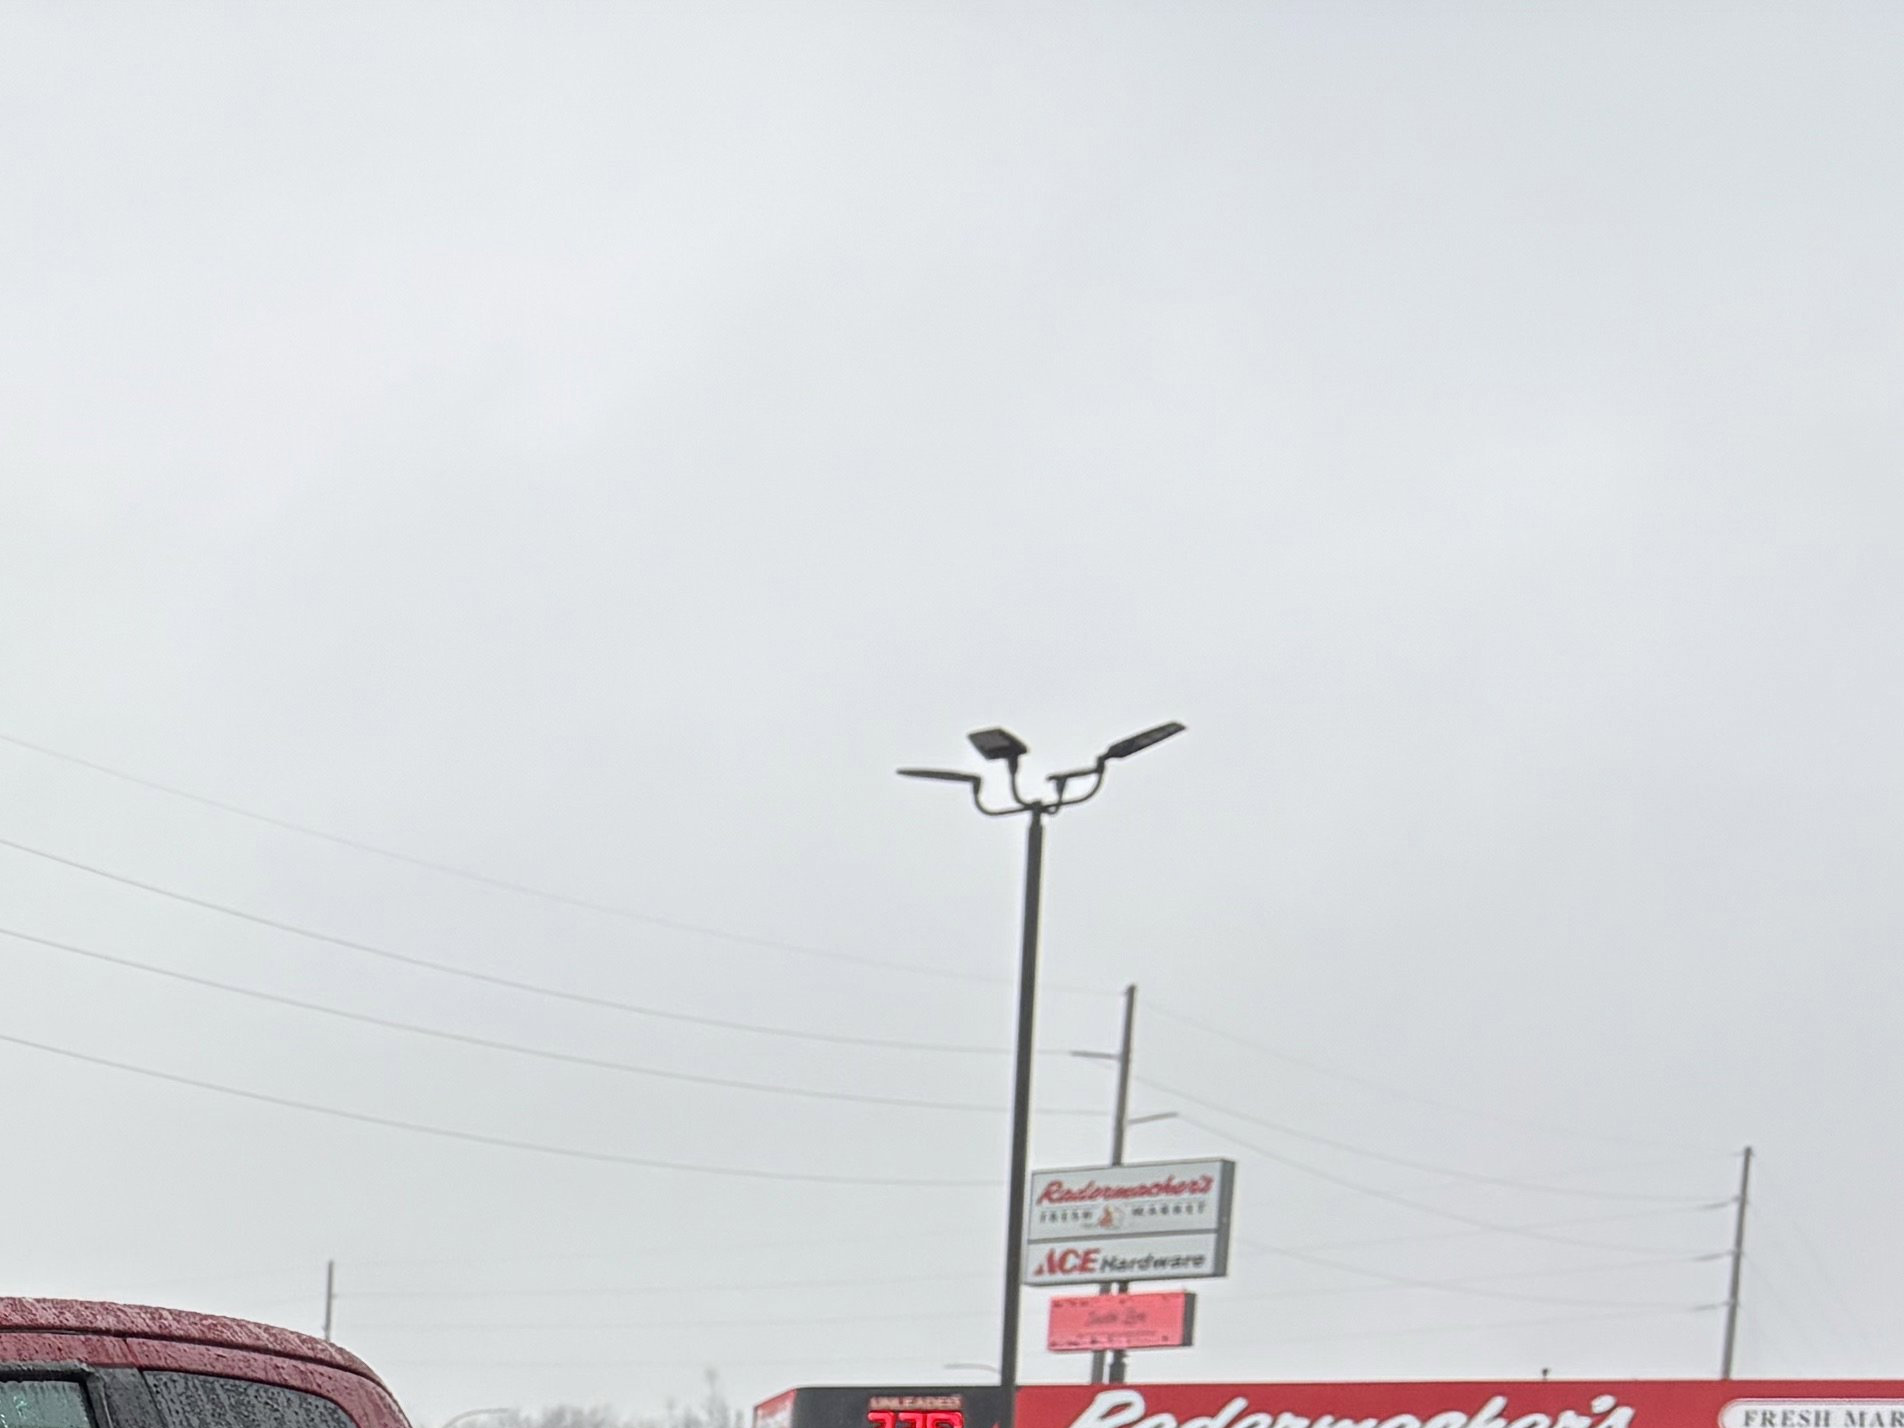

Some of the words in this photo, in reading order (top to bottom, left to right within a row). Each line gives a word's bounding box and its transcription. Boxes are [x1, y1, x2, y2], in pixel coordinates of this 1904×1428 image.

[1037, 1174, 1214, 1205] Radermacher's
[1033, 1247, 1100, 1277] ACE
[1100, 1253, 1206, 1273] Hardware
[1743, 1409, 1831, 1428] FRESH
